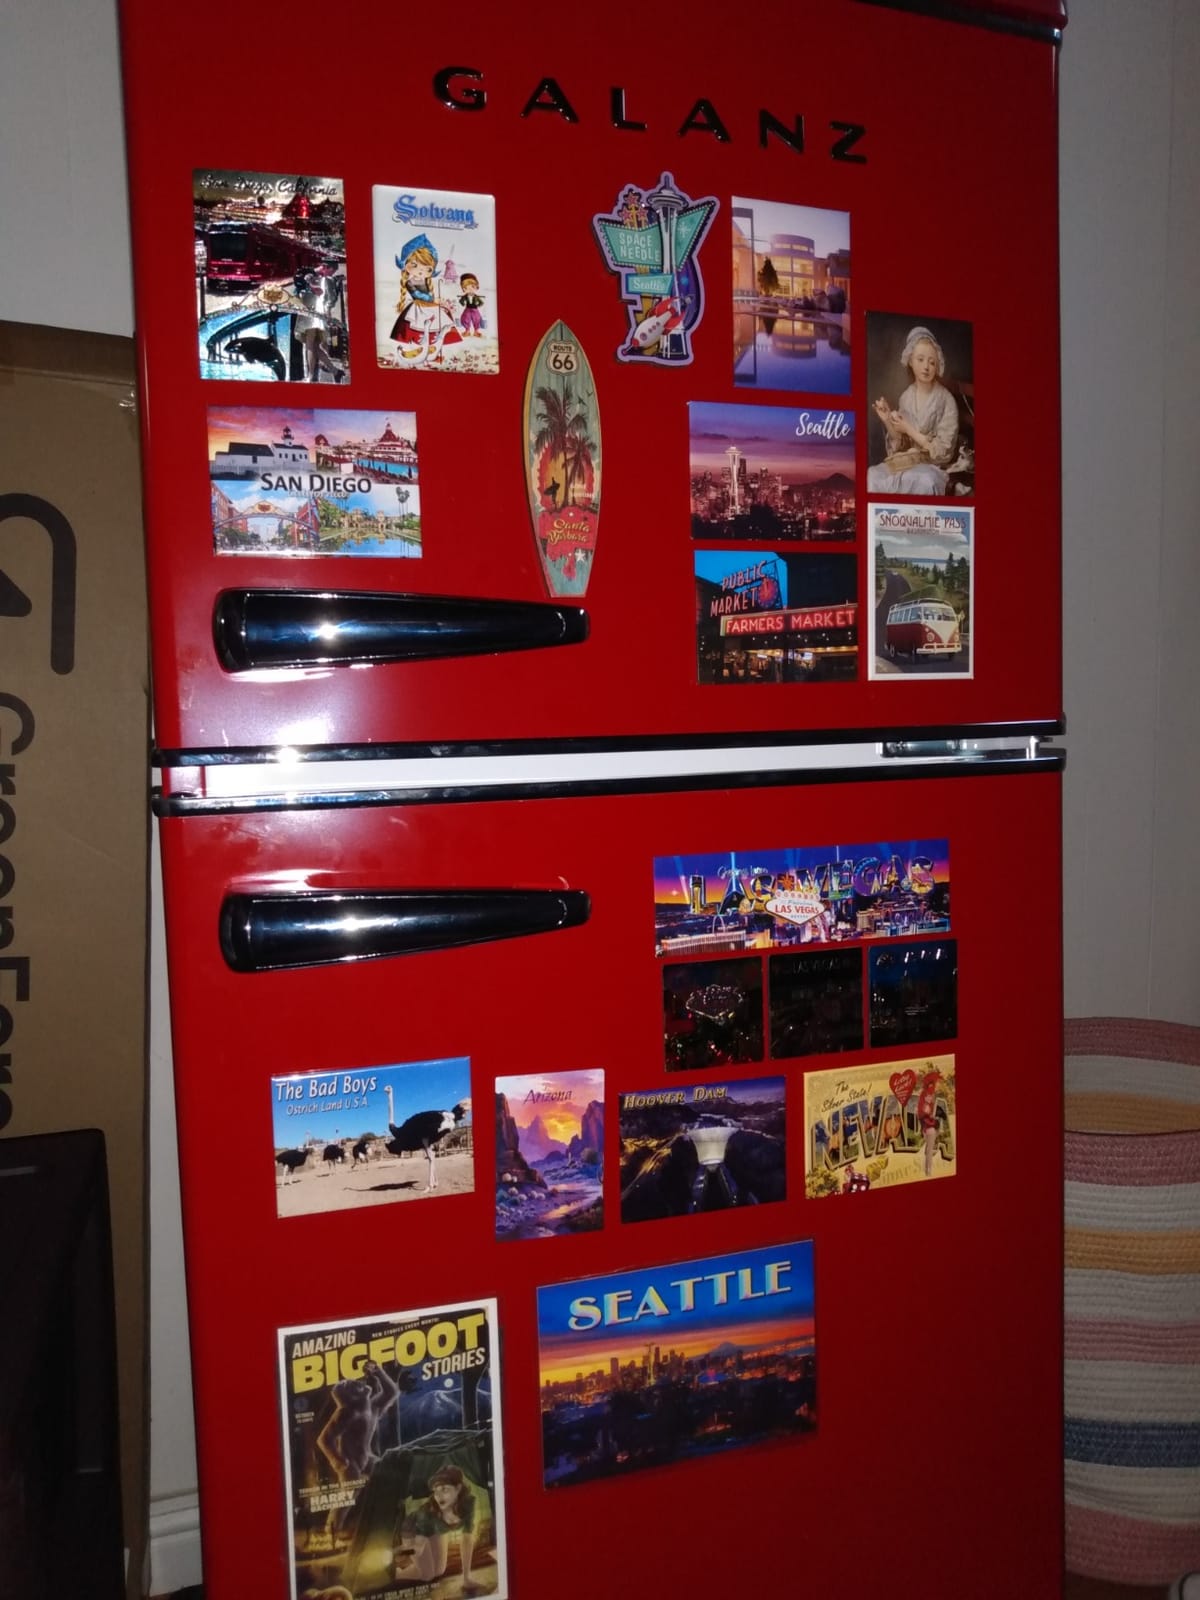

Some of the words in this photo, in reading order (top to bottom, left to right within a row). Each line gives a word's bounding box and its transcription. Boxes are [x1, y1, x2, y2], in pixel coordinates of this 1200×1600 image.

[432, 66, 868, 164] GALANZ
[393, 194, 478, 229] Solvang
[619, 233, 652, 248] SPACE
[620, 245, 661, 262] NEEDLE
[552, 353, 574, 371] 66
[796, 411, 851, 440] Seattle
[261, 472, 303, 492] SAN
[309, 474, 372, 494] DIEGO
[553, 518, 590, 533] Santa
[880, 513, 940, 529] SNOQUALMIE
[944, 516, 967, 529] PASS
[722, 560, 768, 592] PUBLIC
[710, 586, 757, 617] MARKET
[726, 614, 784, 634] FARMERS
[791, 609, 855, 630] MARKET
[775, 903, 792, 914] LAS
[795, 905, 820, 915] VEGAS
[276, 1080, 304, 1102] The
[308, 1077, 338, 1098] Bad
[343, 1074, 378, 1097] Boys
[523, 1088, 573, 1105] Arizona
[623, 1091, 685, 1109] HOOVER
[692, 1085, 728, 1102] DAM
[835, 1080, 849, 1096] The
[286, 1100, 319, 1116] Ostrich
[320, 1099, 344, 1113] Land
[811, 1094, 955, 1173] NEVADA
[568, 1260, 792, 1331] SEATTLE
[291, 1312, 486, 1394] BIGFOOT
[292, 1329, 357, 1359] AMAZING
[421, 1347, 486, 1382] STORIES
[310, 1489, 355, 1506] HARRY
